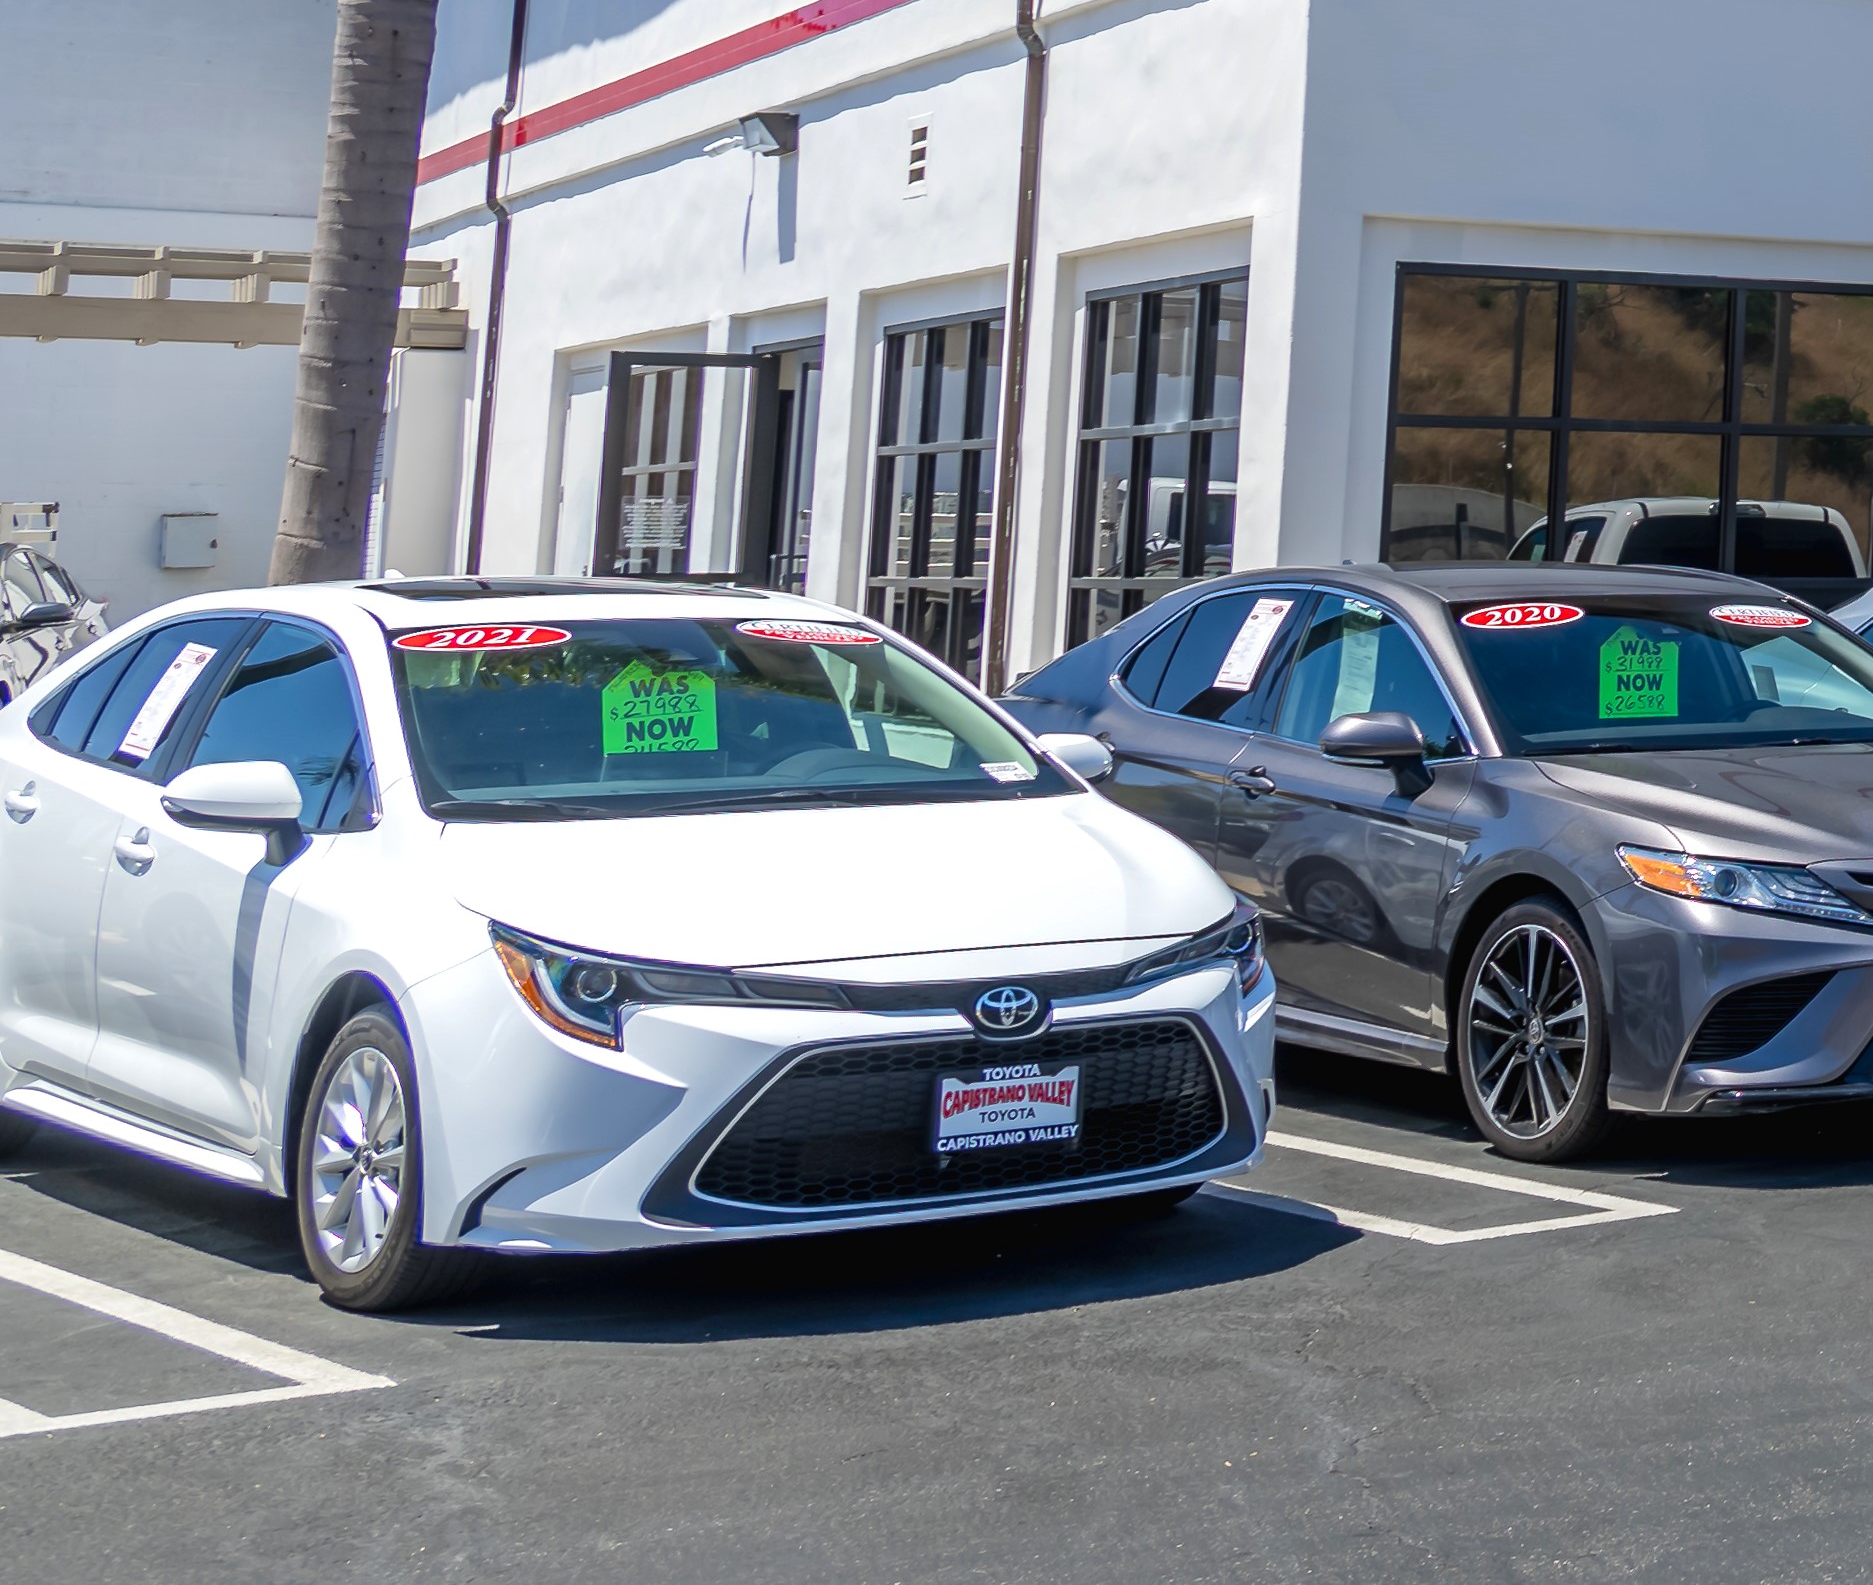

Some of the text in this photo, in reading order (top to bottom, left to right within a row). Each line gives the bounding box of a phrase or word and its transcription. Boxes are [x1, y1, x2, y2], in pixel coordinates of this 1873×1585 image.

[1485, 606, 1561, 625] 2020
[425, 628, 538, 648] 2021
[1620, 639, 1661, 655] WAS
[629, 675, 690, 698] WAS
[1617, 674, 1663, 692] NOW
[626, 716, 695, 743] NOW
[982, 1064, 1041, 1081] TOYOTA
[943, 1079, 1075, 1118] CAPISTRANO VALLEY
[979, 1107, 1036, 1123] TOYOTA
[937, 1124, 1079, 1152] CAPISTRANO VALLEY
